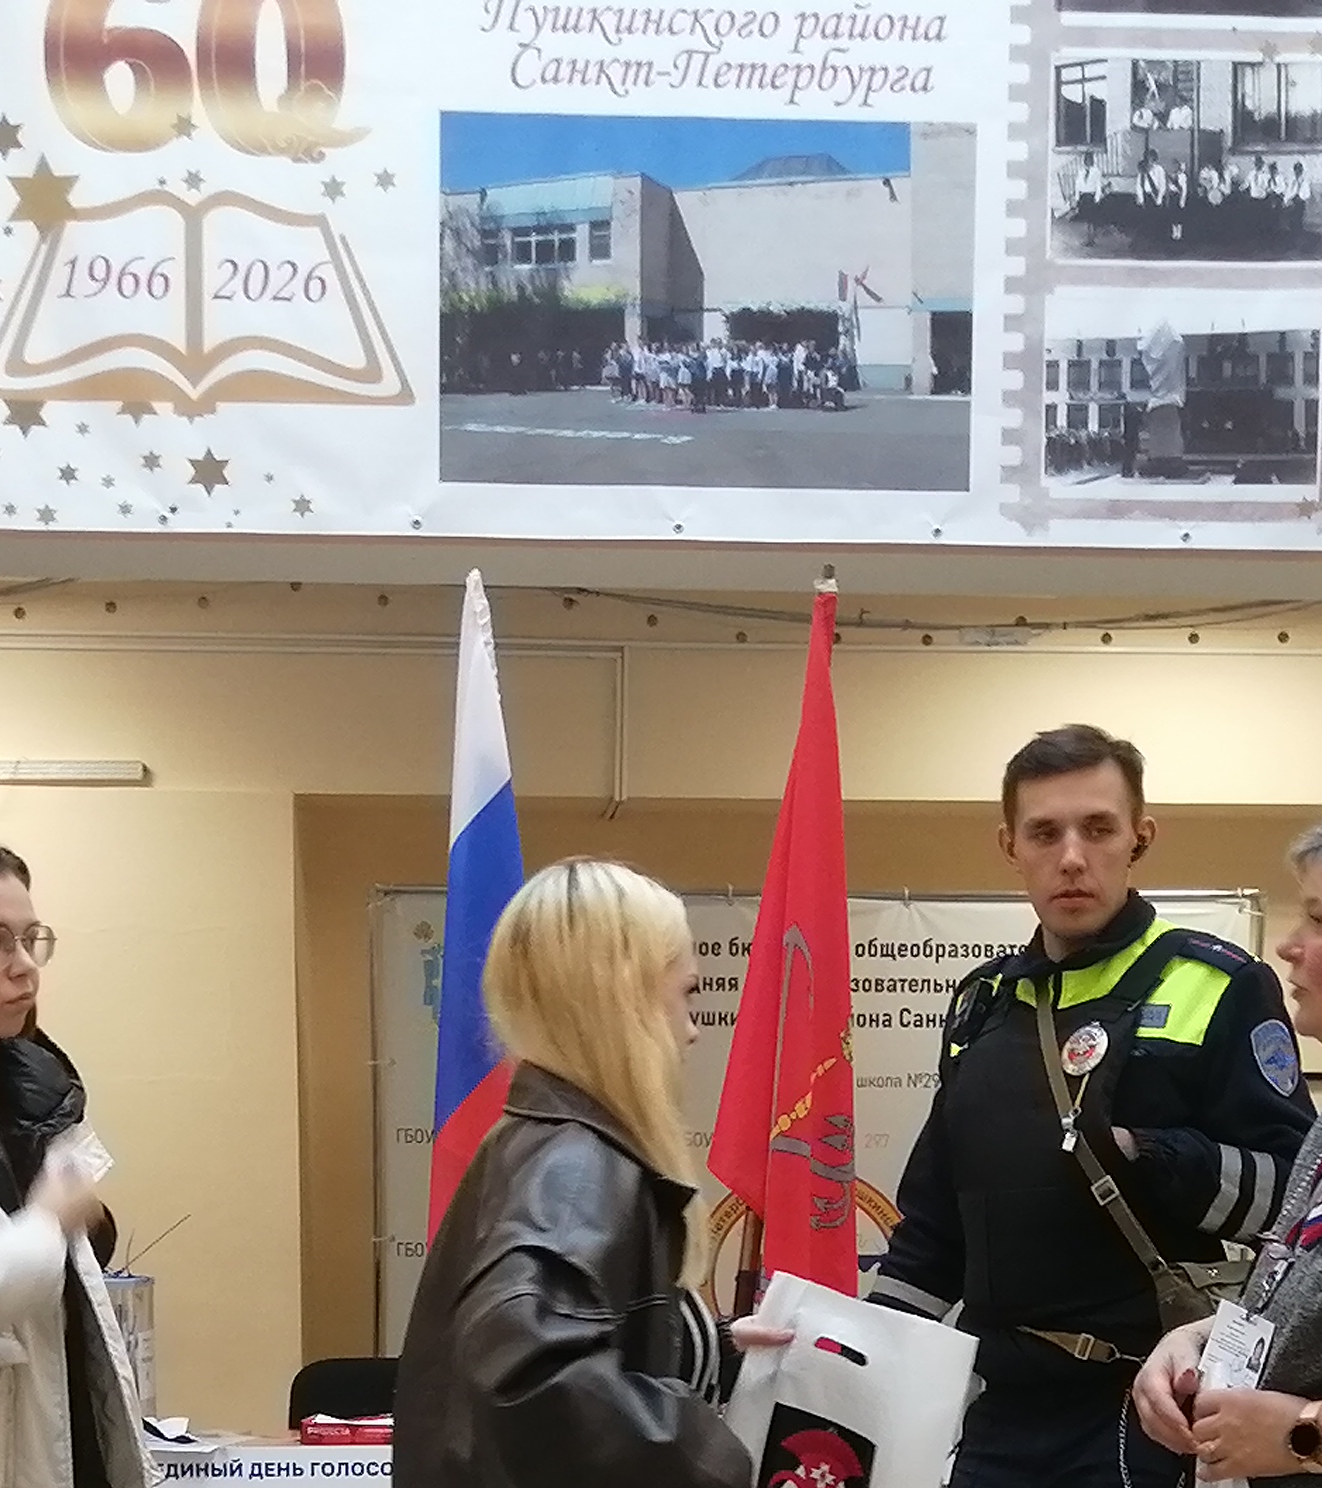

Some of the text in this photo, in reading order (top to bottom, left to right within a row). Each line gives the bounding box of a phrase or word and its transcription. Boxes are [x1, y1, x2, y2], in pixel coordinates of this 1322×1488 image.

[480, 0, 948, 54] Пушкинского района
[510, 43, 934, 107] Санкт-Петербурга
[57, 254, 176, 300] 1966
[211, 257, 333, 302] 2026
[396, 1241, 428, 1258] ГБО
[159, 1458, 244, 1479] ДИНЫЙ
[248, 1461, 304, 1479] ДЕНЬ
